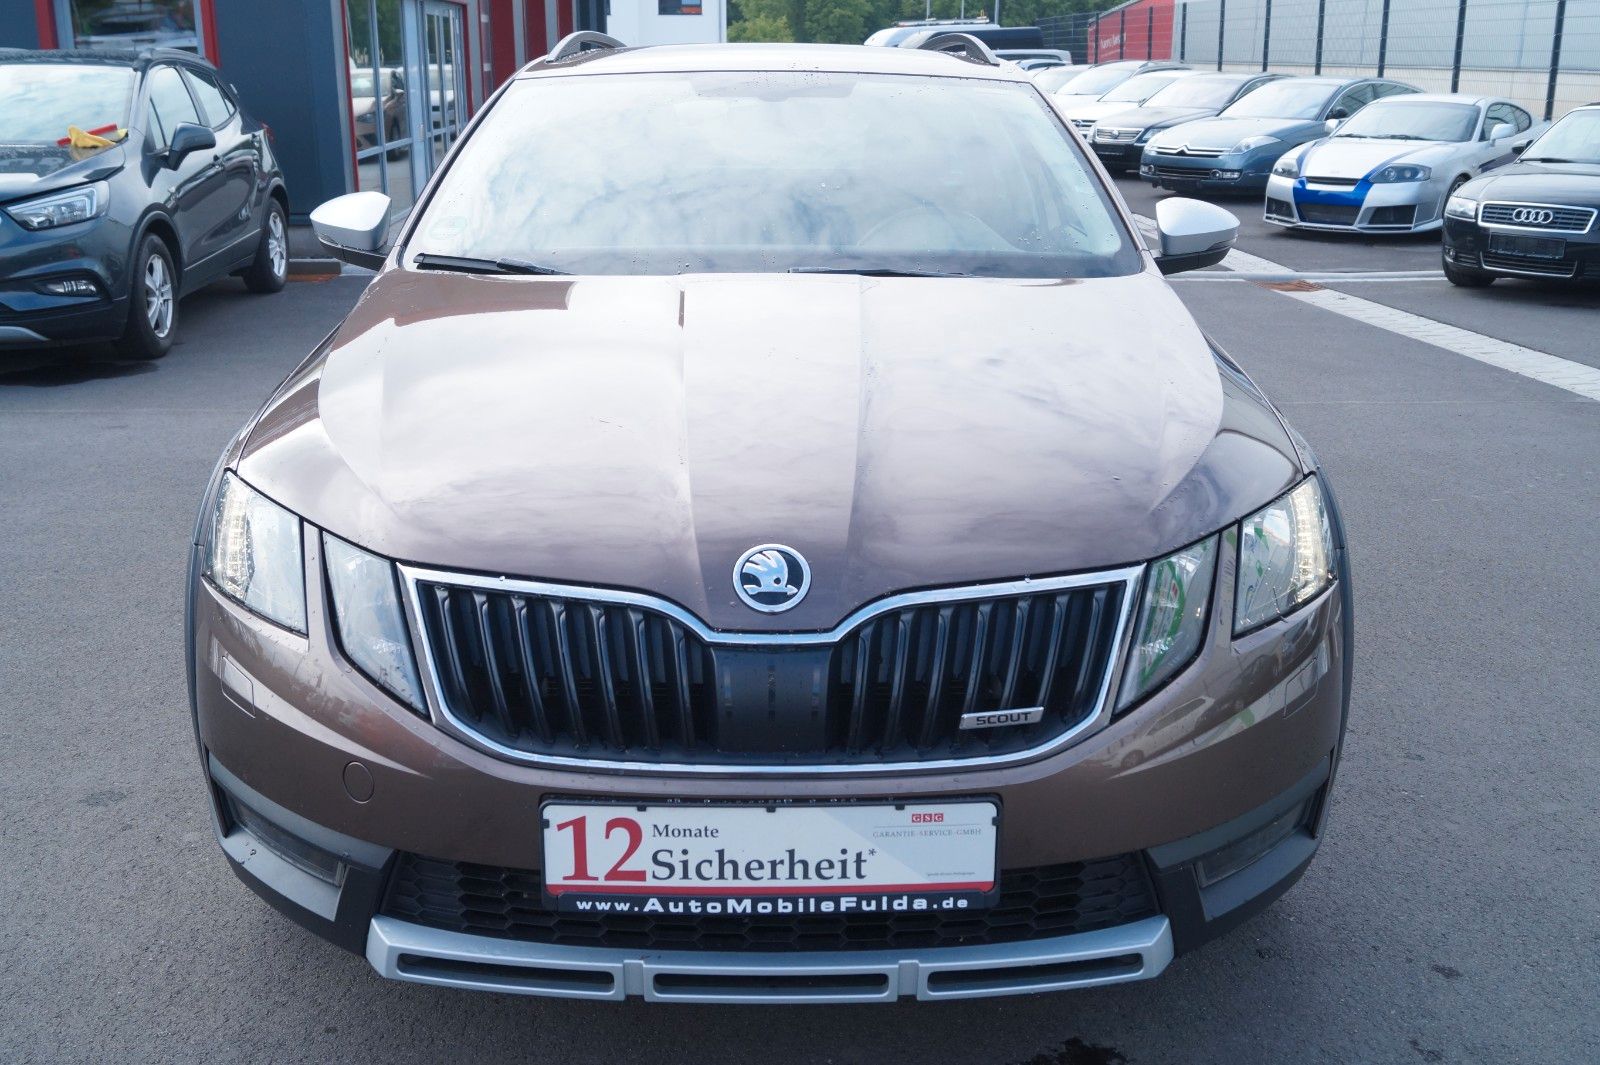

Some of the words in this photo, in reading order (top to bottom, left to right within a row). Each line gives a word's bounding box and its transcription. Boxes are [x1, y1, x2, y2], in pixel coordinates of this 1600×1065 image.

[976, 712, 1031, 725] SCOUT
[911, 813, 944, 823] GSG
[652, 824, 719, 838] Monate
[872, 830, 914, 838] GARANTIE
[919, 828, 953, 837] SERVICE
[556, 815, 647, 882] 12
[576, 896, 968, 913] www.AutoMobileFulda.de
